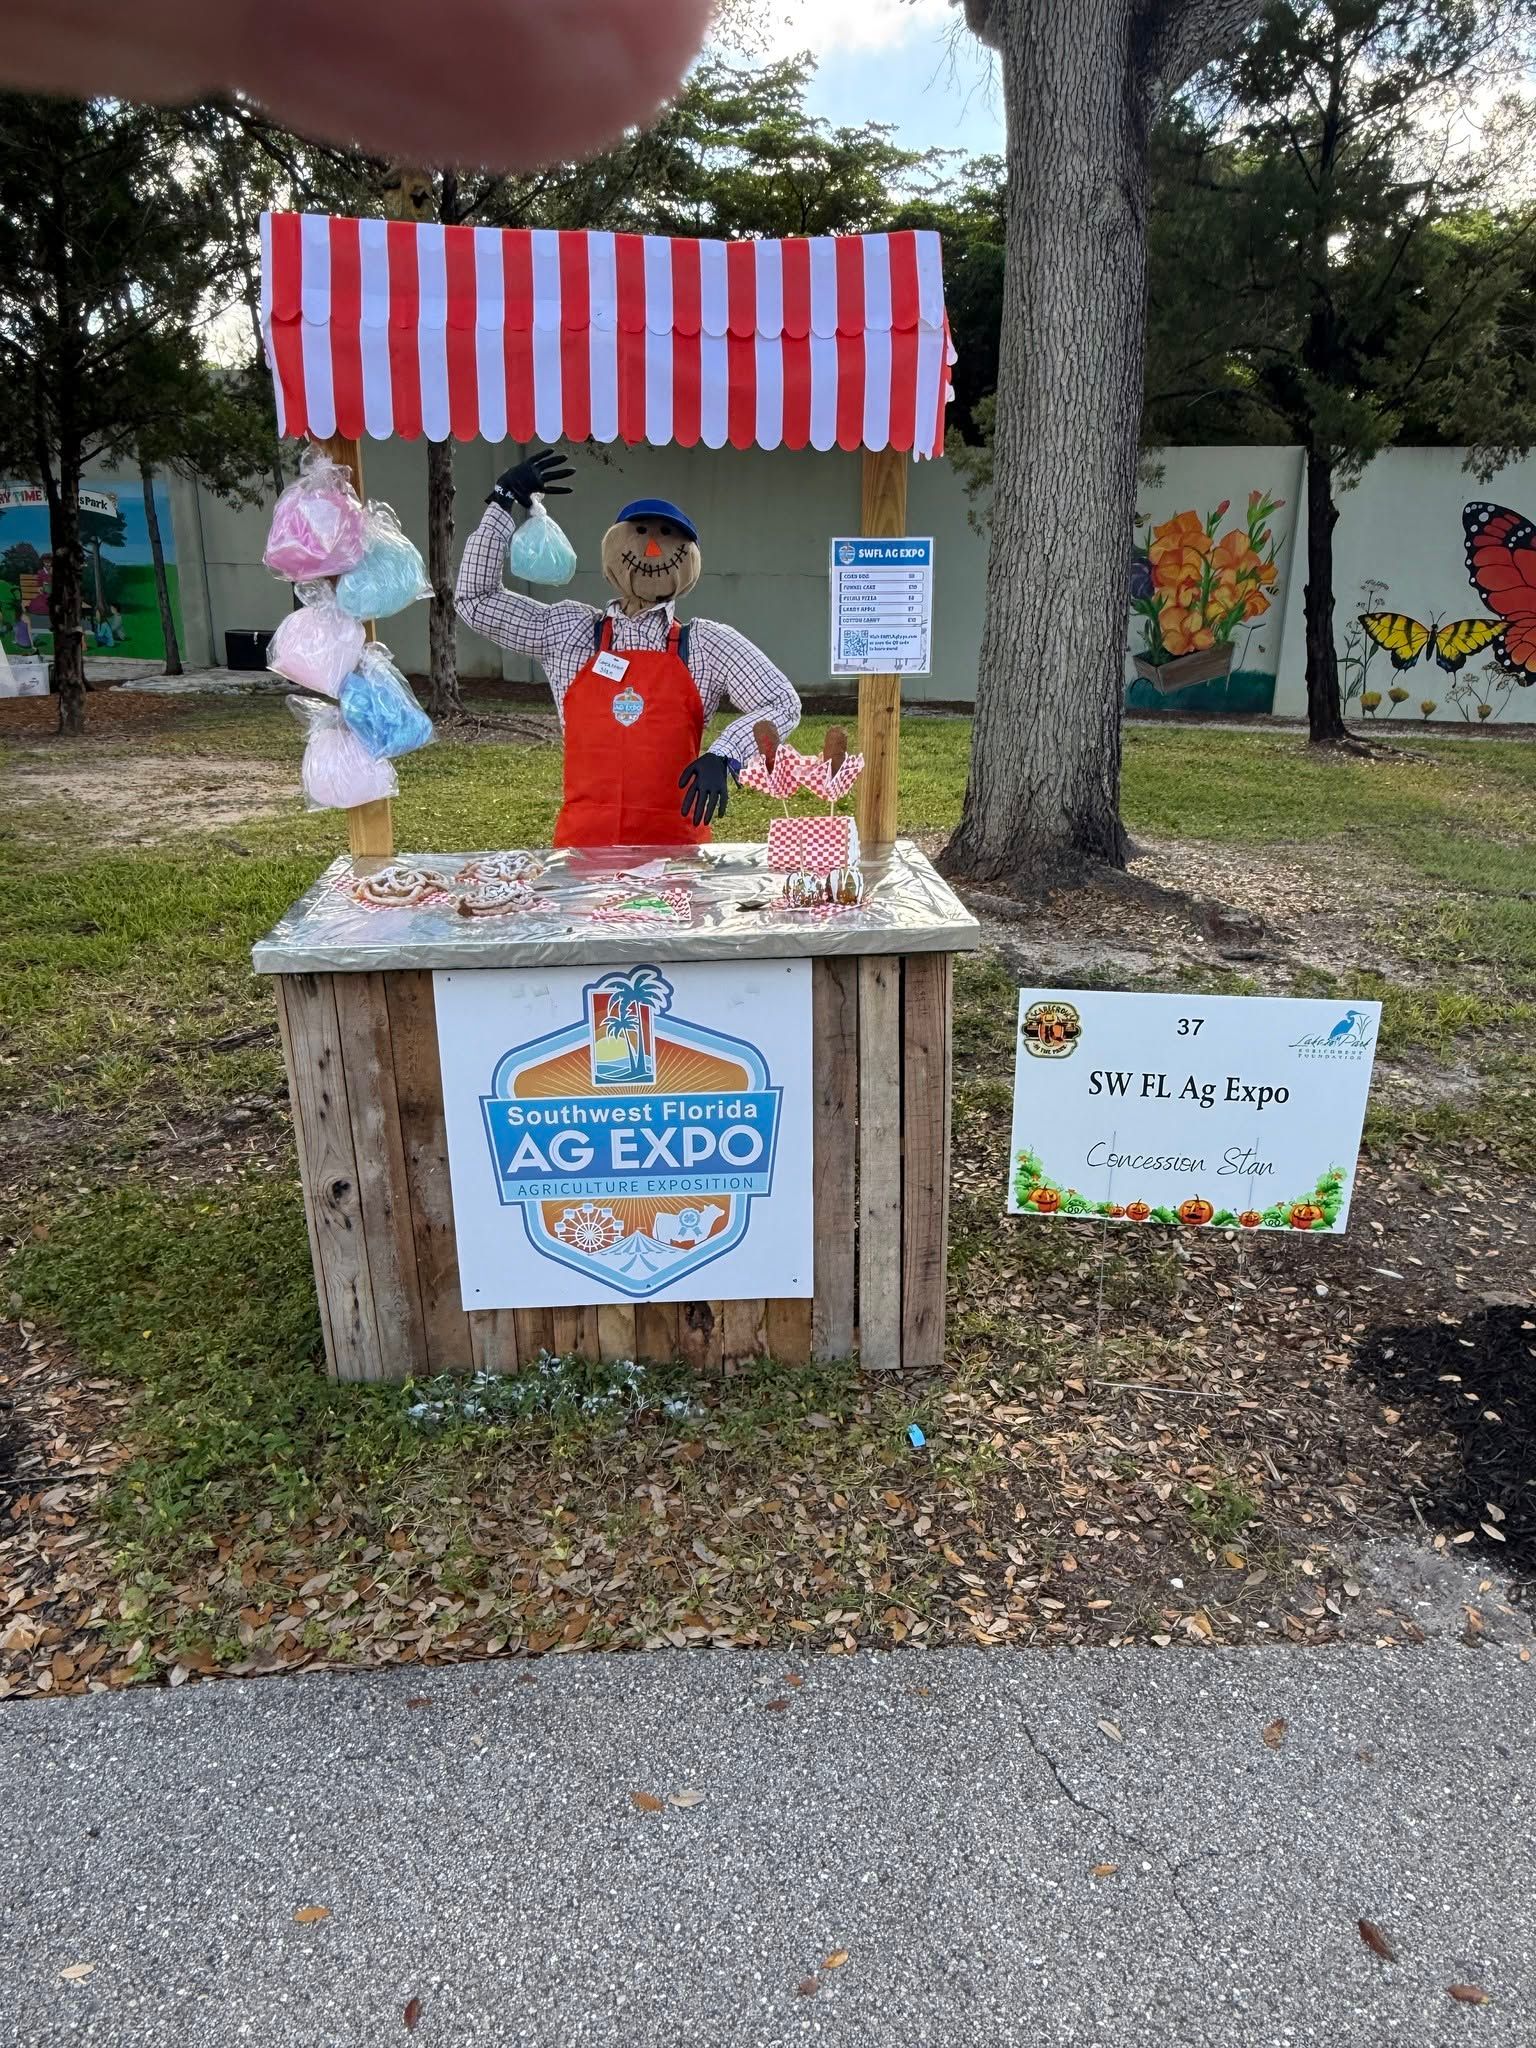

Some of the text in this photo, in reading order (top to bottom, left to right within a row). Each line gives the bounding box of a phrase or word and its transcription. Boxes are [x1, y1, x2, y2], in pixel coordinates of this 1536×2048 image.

[13, 490, 42, 502] TIME
[85, 496, 108, 510] Park
[858, 548, 925, 558] SWFL AG EXPO
[1177, 1018, 1205, 1036] 37
[1088, 1070, 1290, 1110] SW FL Ag Expo
[507, 1099, 758, 1126] Southwest Florida
[507, 1124, 764, 1174] AG EXPO
[1086, 1141, 1275, 1176] Concession Stan
[517, 1176, 754, 1197] AGRICULTURE EXPOSITION
